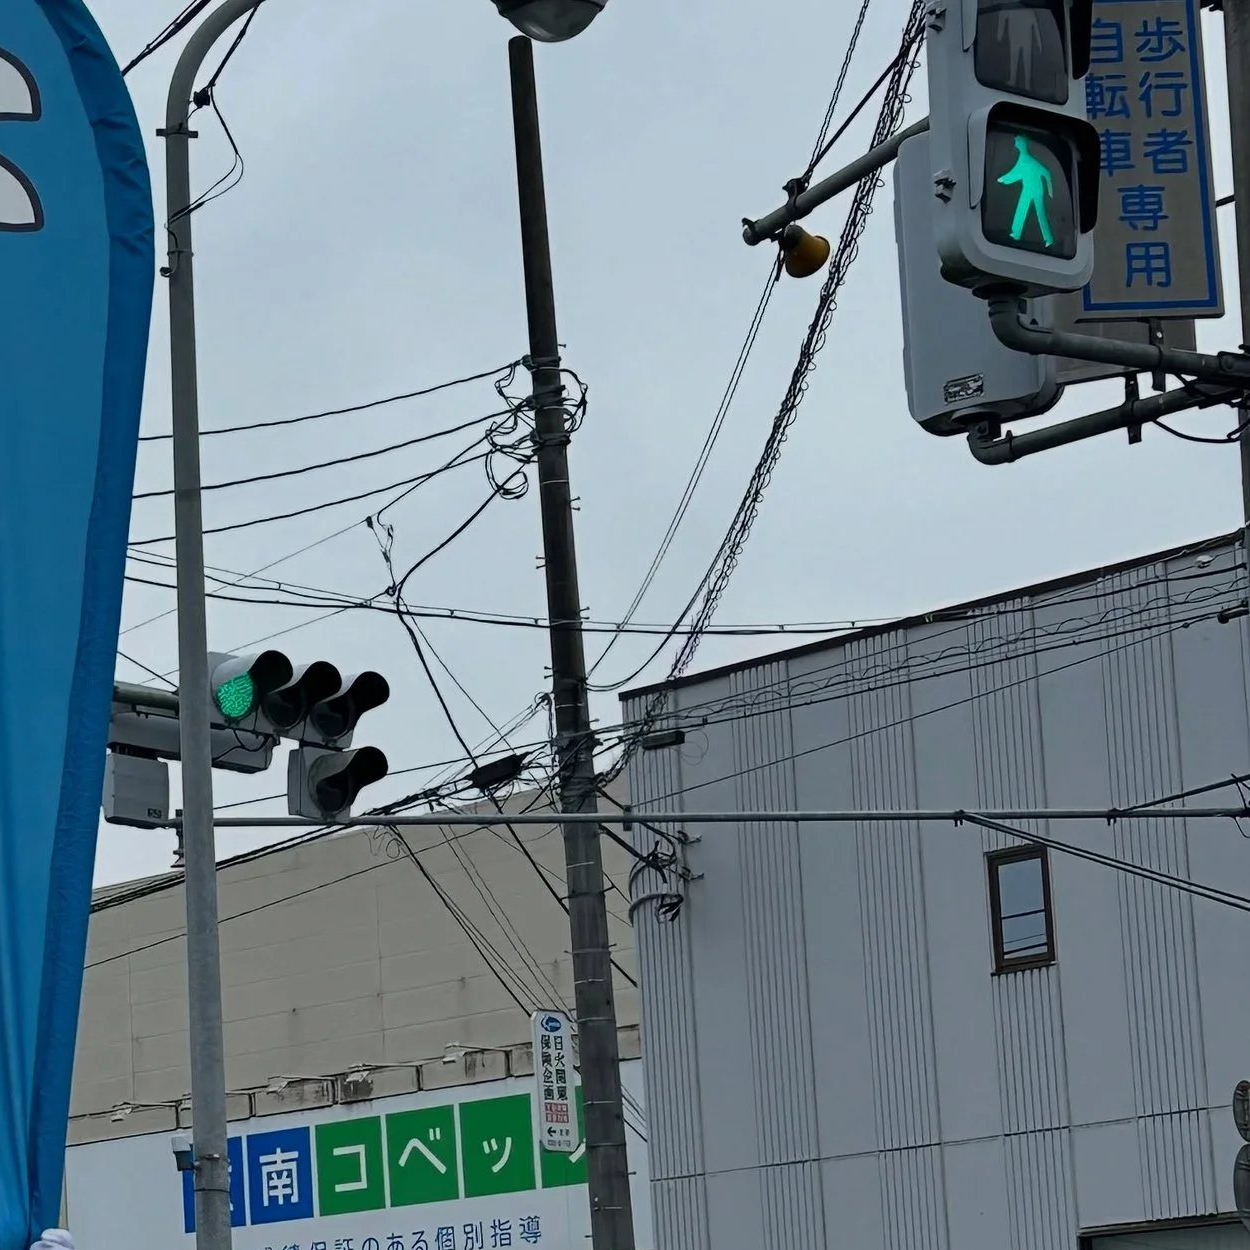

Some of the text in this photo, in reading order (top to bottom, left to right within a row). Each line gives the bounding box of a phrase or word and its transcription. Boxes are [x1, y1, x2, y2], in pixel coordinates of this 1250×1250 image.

[1086, 18, 1136, 177] 自転車
[1134, 16, 1192, 175] 歩行者
[1117, 184, 1172, 288] 専用
[226, 1126, 587, 1212] 南コベッ
